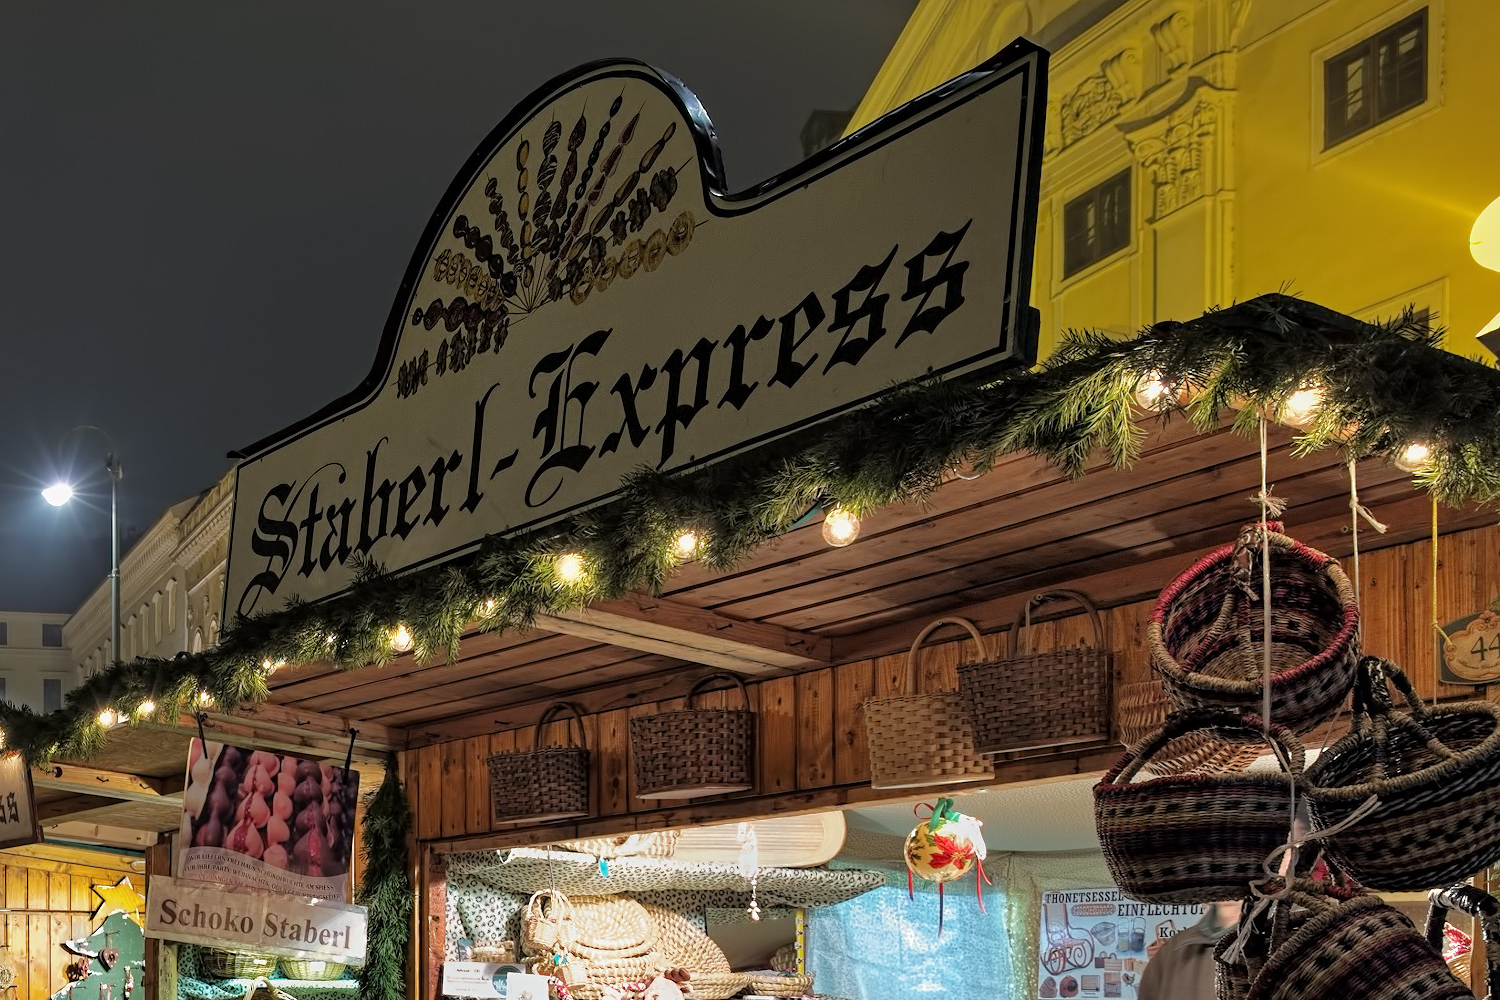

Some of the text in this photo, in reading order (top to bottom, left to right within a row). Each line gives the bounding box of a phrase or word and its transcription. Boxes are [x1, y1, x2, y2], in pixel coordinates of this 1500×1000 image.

[1045, 890, 1125, 904] THONETSESSEL
[159, 899, 350, 950] Schoko Staberl
